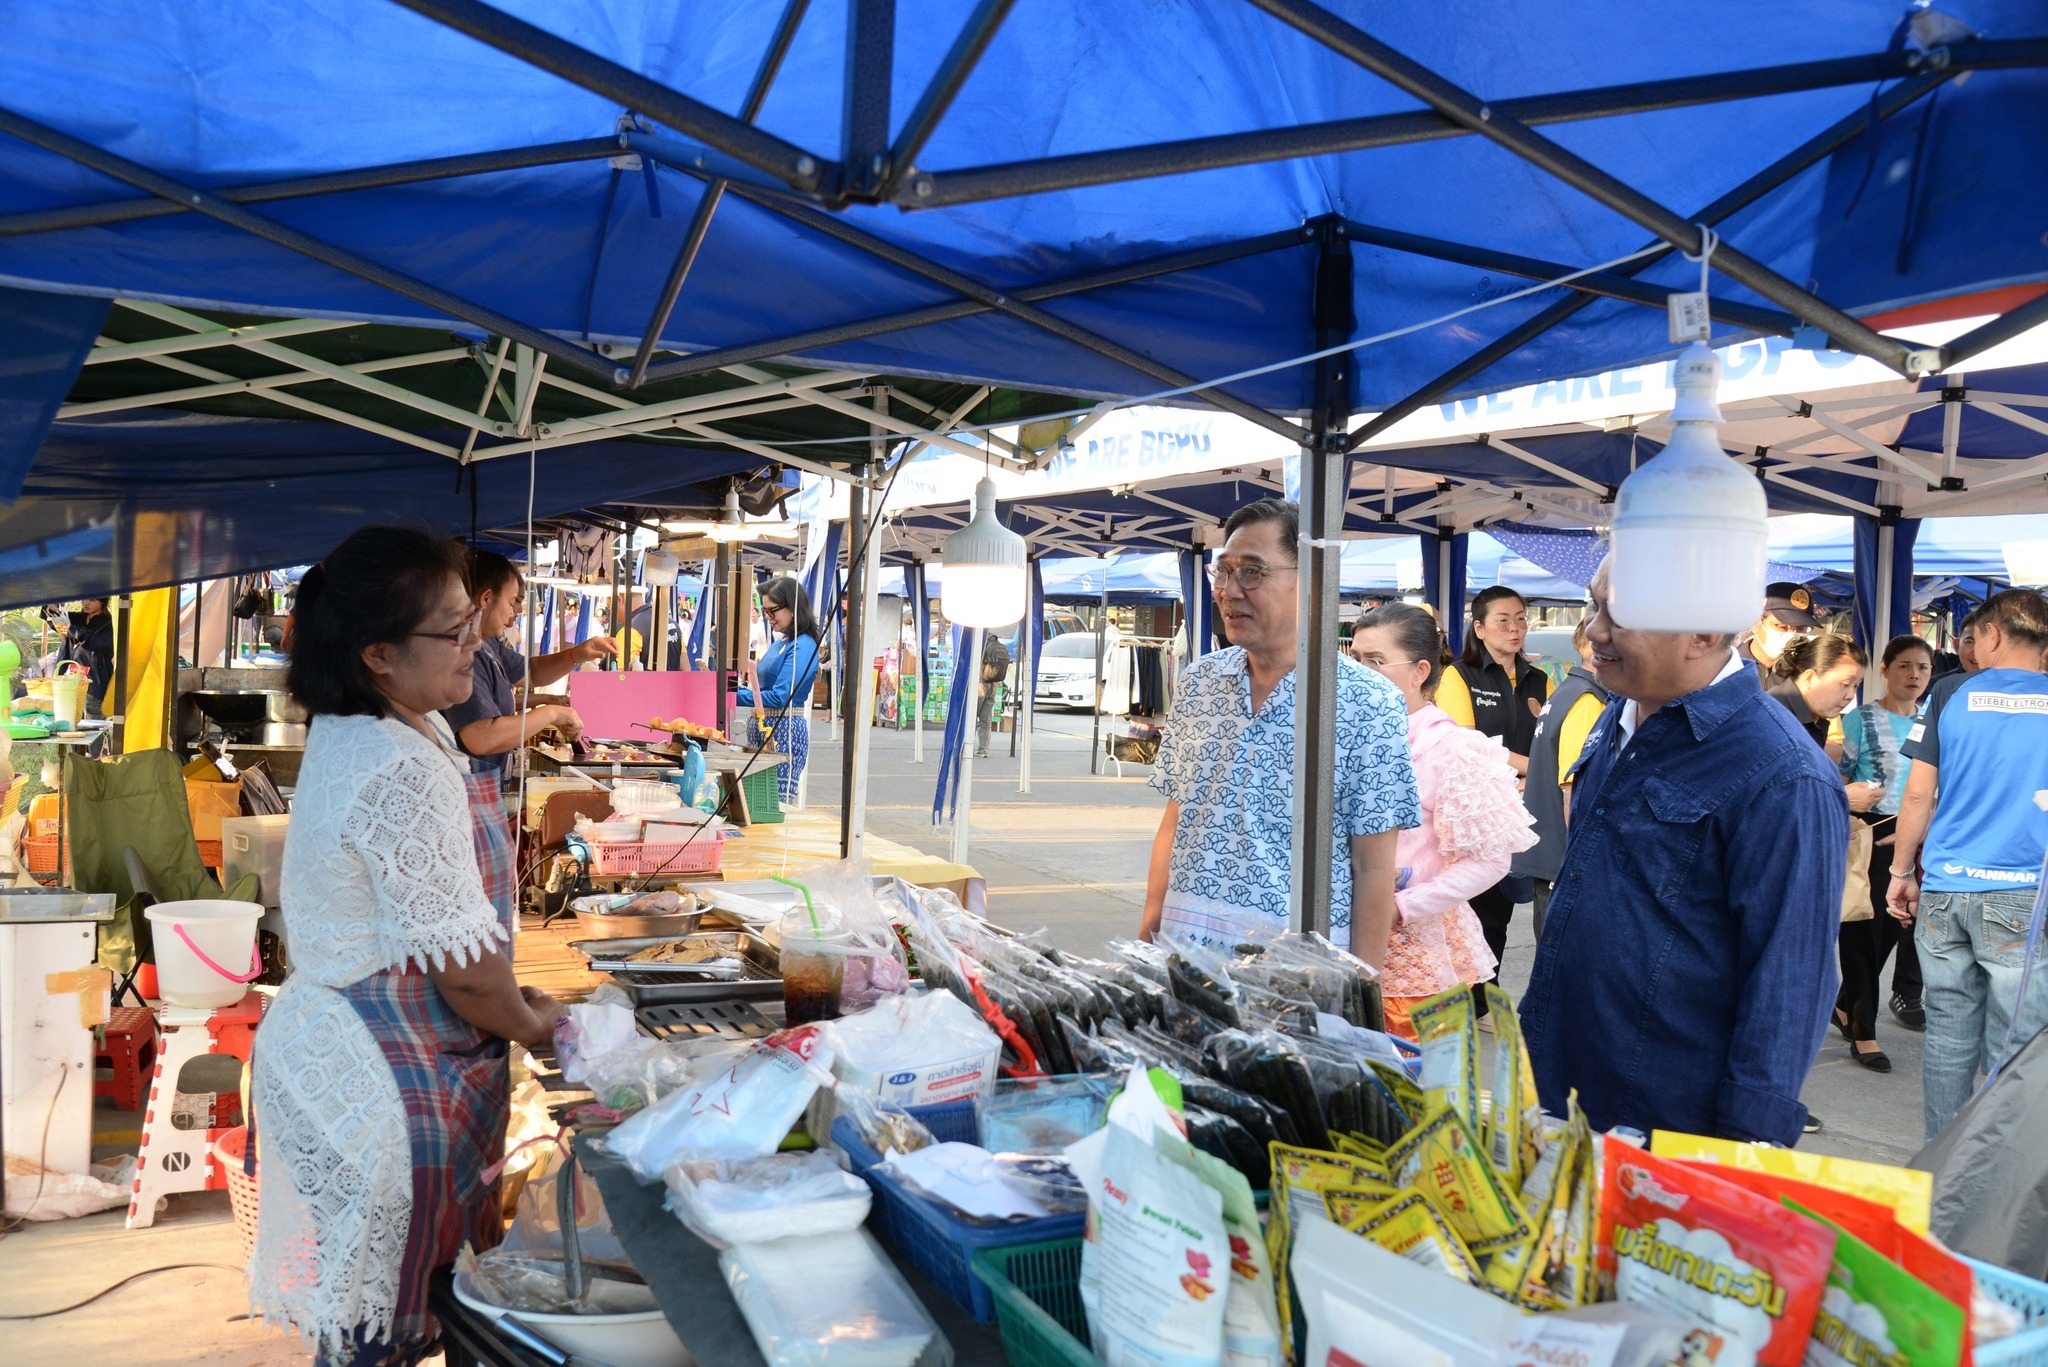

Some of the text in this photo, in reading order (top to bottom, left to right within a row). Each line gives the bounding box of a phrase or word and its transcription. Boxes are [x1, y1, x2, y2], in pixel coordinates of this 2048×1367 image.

[1085, 432, 1134, 475] ARE
[1137, 418, 1214, 468] BGPU
[1971, 697, 2011, 708] STIEBEL
[1965, 866, 2037, 883] YANMAR
